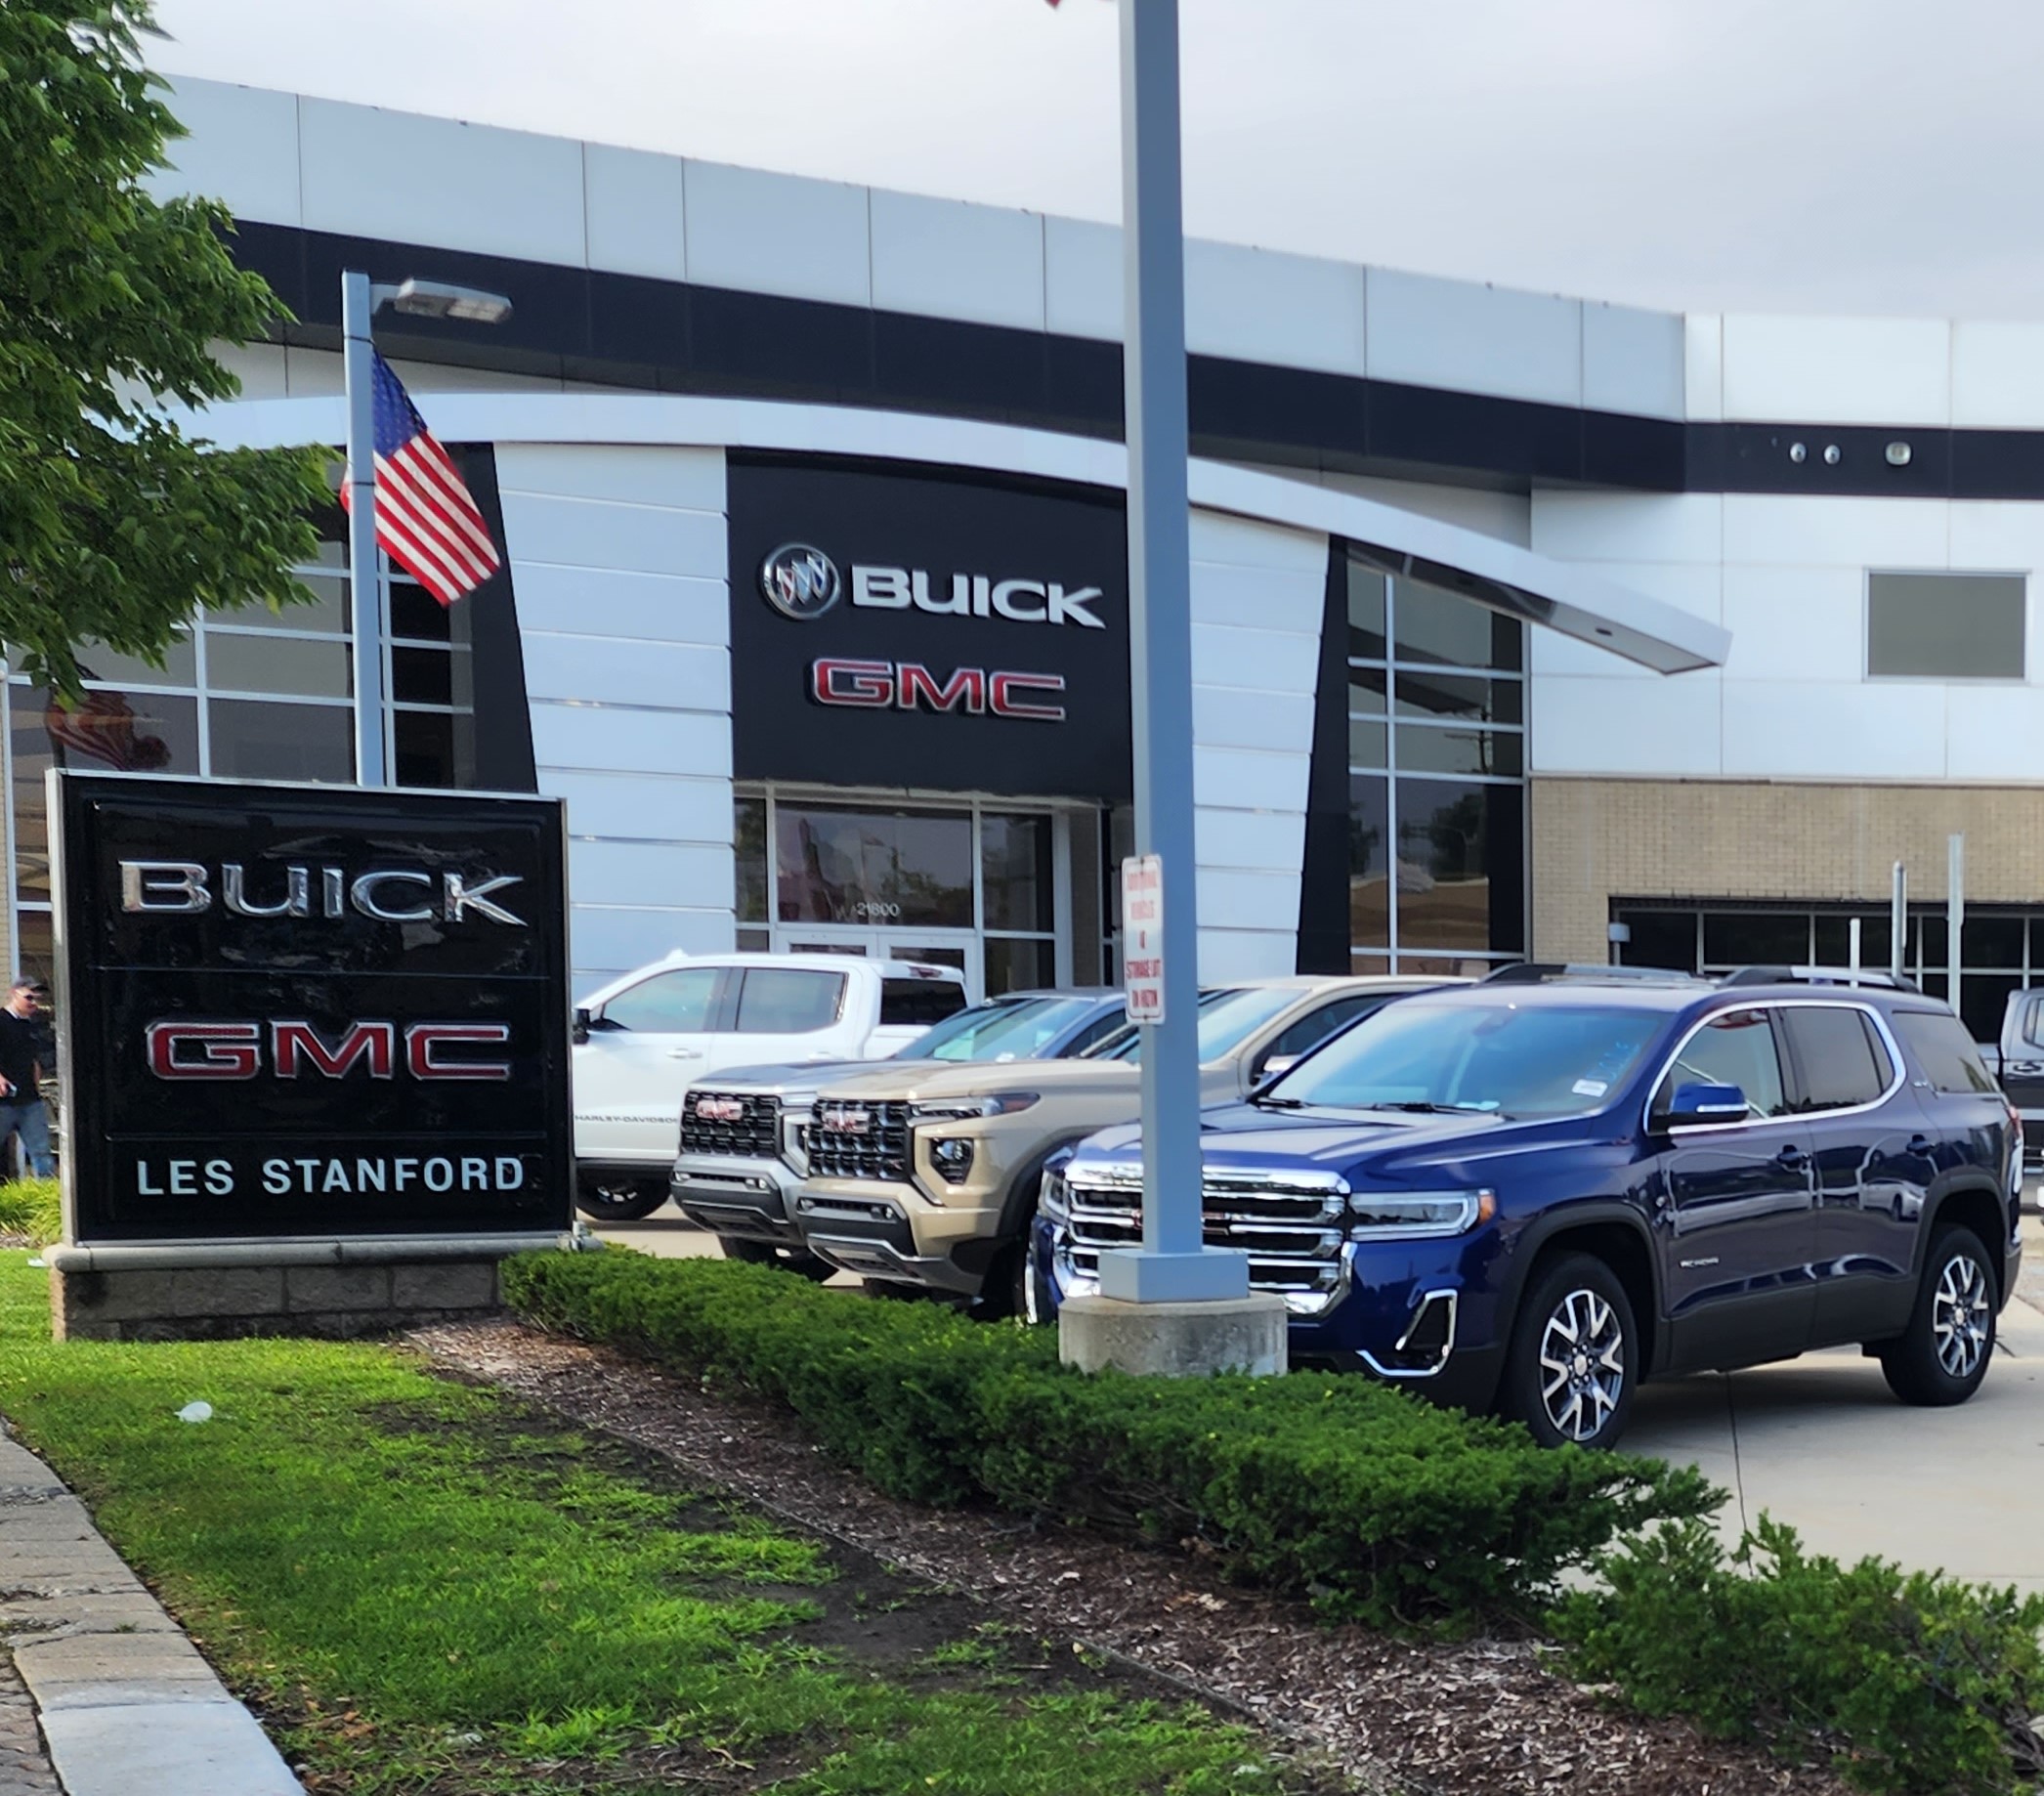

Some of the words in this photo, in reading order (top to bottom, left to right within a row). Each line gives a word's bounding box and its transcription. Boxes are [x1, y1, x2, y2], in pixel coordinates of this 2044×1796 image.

[852, 564, 1106, 628] BUICK
[813, 658, 1066, 721] GMC
[118, 860, 529, 927] BUICK
[145, 1020, 510, 1082] GMC
[137, 1159, 234, 1195] LES
[262, 1157, 524, 1194] STANFORD
